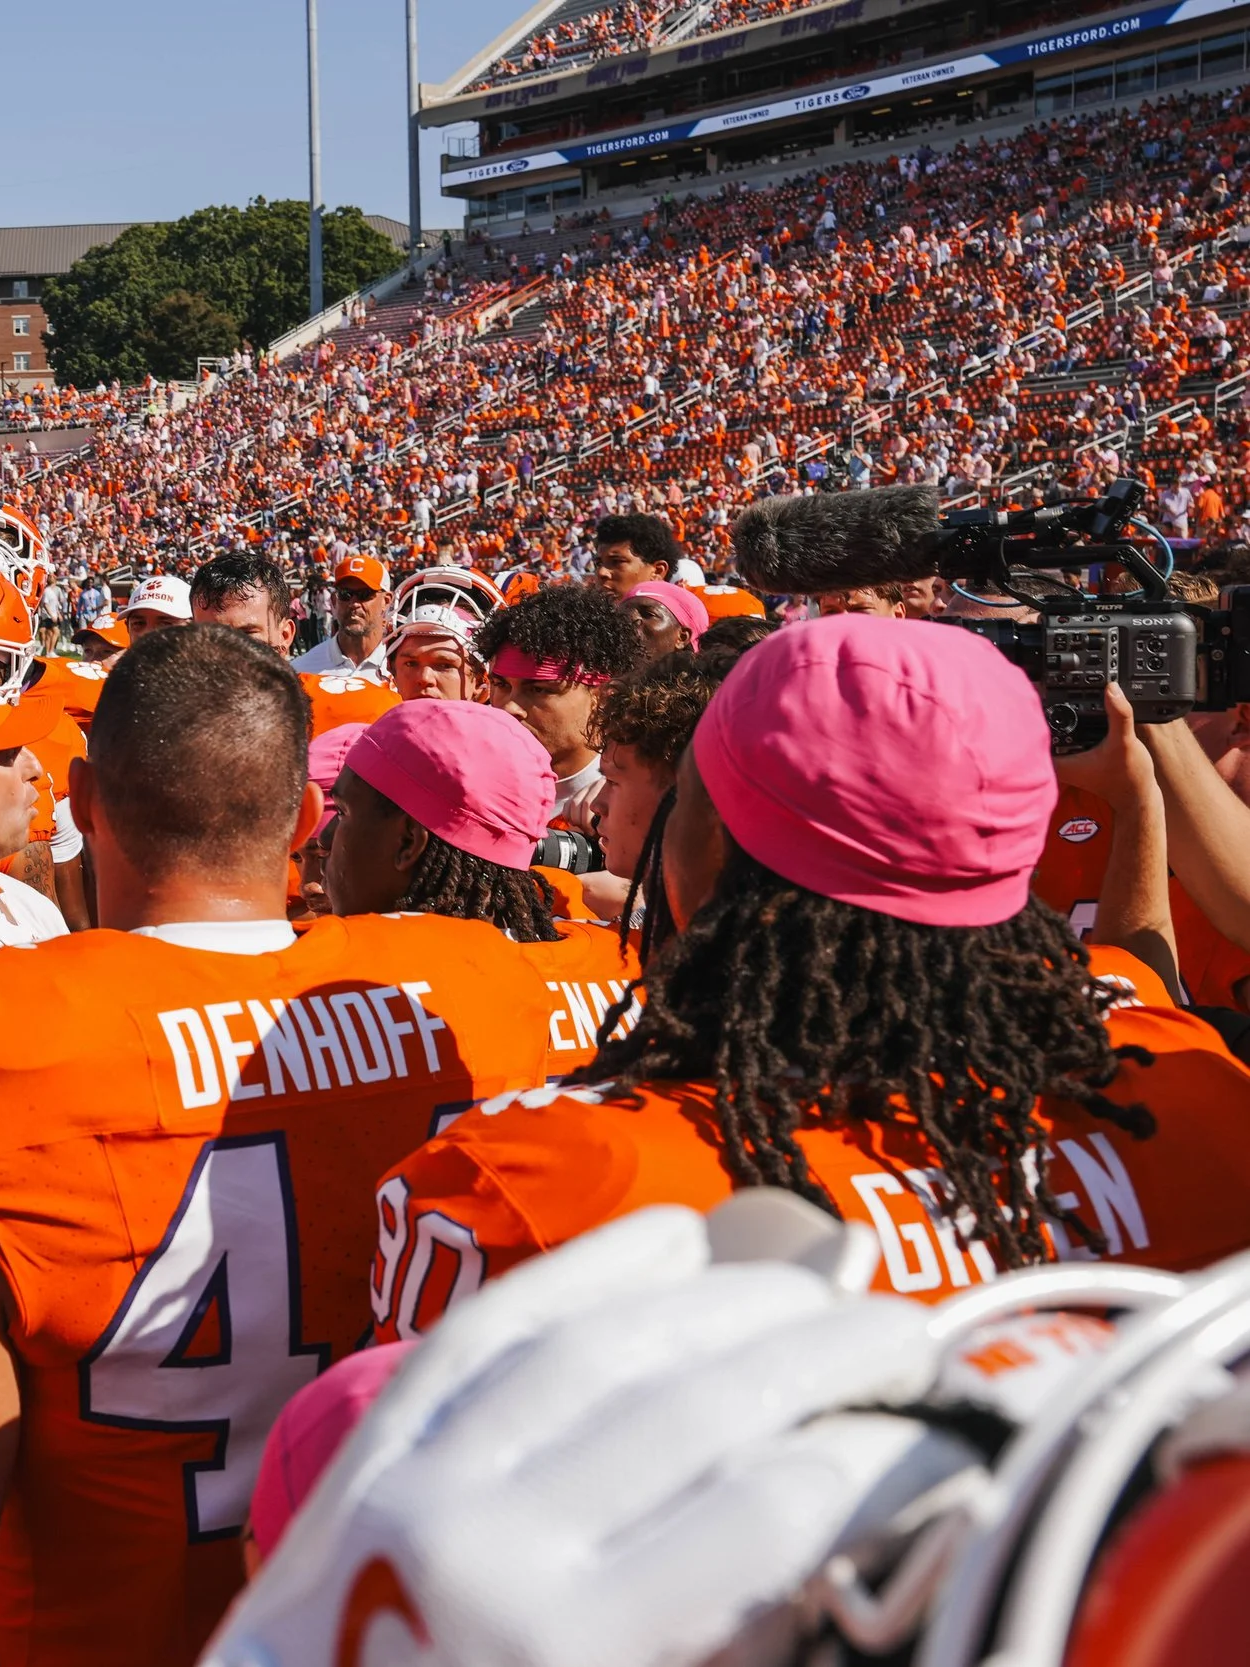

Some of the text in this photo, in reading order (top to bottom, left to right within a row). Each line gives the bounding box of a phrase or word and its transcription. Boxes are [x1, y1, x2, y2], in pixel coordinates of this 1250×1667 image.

[1027, 17, 1141, 56] TIGERSFORD.COM
[901, 69, 931, 86] VETERAN
[794, 92, 840, 110] TIGERS
[722, 113, 748, 126] VETERAN
[586, 130, 670, 156] TIGERSFORD.COM
[468, 165, 505, 180] TIGERS
[350, 557, 365, 572] C
[133, 592, 175, 604] CLEMSON
[1132, 618, 1174, 626] SONY
[1064, 821, 1094, 834] ACC
[157, 980, 446, 1111] DENHOFF
[850, 1131, 1150, 1294] GREN
[370, 1175, 488, 1342] 90
